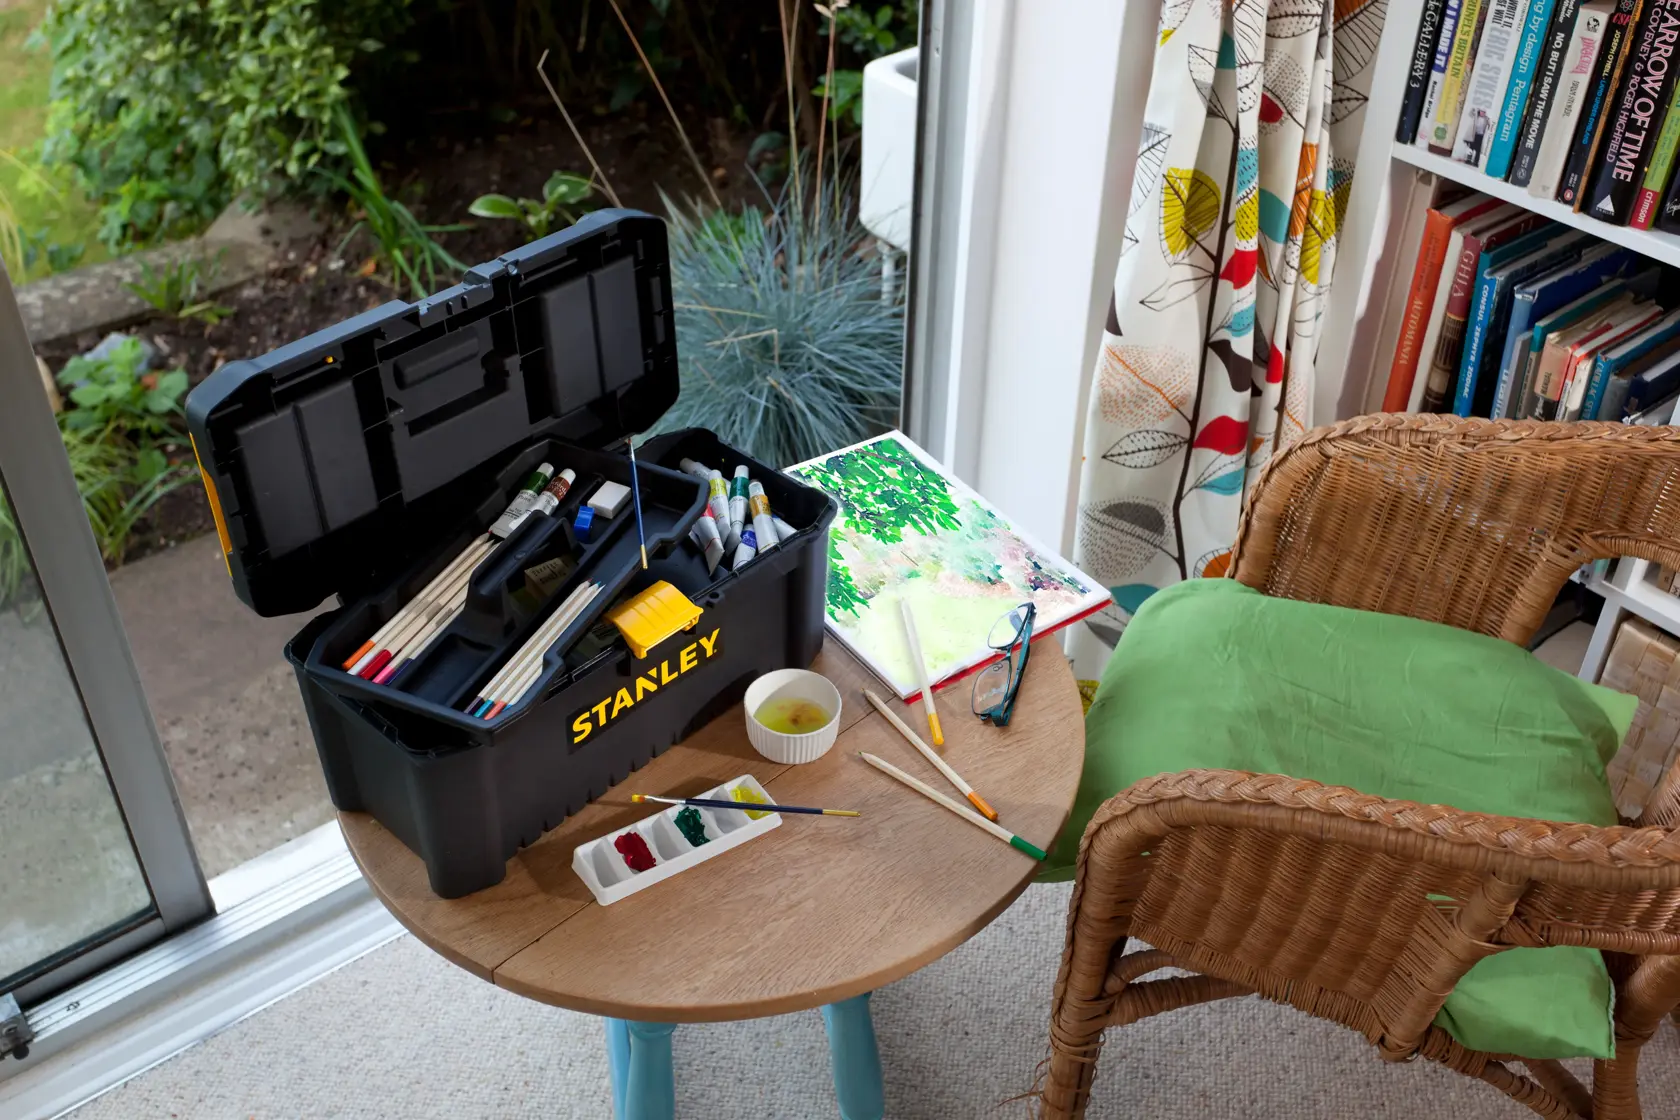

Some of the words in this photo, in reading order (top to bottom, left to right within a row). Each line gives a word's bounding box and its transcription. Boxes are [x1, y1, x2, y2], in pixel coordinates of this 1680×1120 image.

[1491, 9, 1506, 25] WILL
[1529, 15, 1544, 33] by
[1638, 7, 1662, 60] COVENEY
[1437, 17, 1455, 54] MADE
[1484, 27, 1512, 62] ERIC
[1552, 32, 1566, 49] NO,
[1611, 29, 1622, 54] JOSEPH
[1434, 54, 1447, 68] IT
[1450, 38, 1468, 79] BRITAIN
[1518, 33, 1538, 74] design
[1547, 50, 1561, 73] BUT
[1570, 36, 1597, 75] DRACULA
[1641, 10, 1680, 100] ARROW
[1409, 80, 1420, 89] 3
[1472, 62, 1502, 109] SYKES
[1539, 76, 1553, 100] SAW
[1622, 74, 1641, 109] ROGER
[1499, 79, 1527, 143] Pentagram
[1533, 98, 1547, 119] THE
[1631, 97, 1655, 129] OF
[1525, 119, 1541, 150] MOVIE
[1606, 110, 1629, 163] HIGHFIELD
[1612, 131, 1647, 183] TIME
[1637, 191, 1654, 223] crimson
[1452, 250, 1475, 297] GHIA
[1477, 284, 1489, 325] CONSUL
[1470, 326, 1482, 362] ZEPHYR
[1463, 366, 1475, 399] ZODIAC
[572, 628, 720, 744] STANLEY
